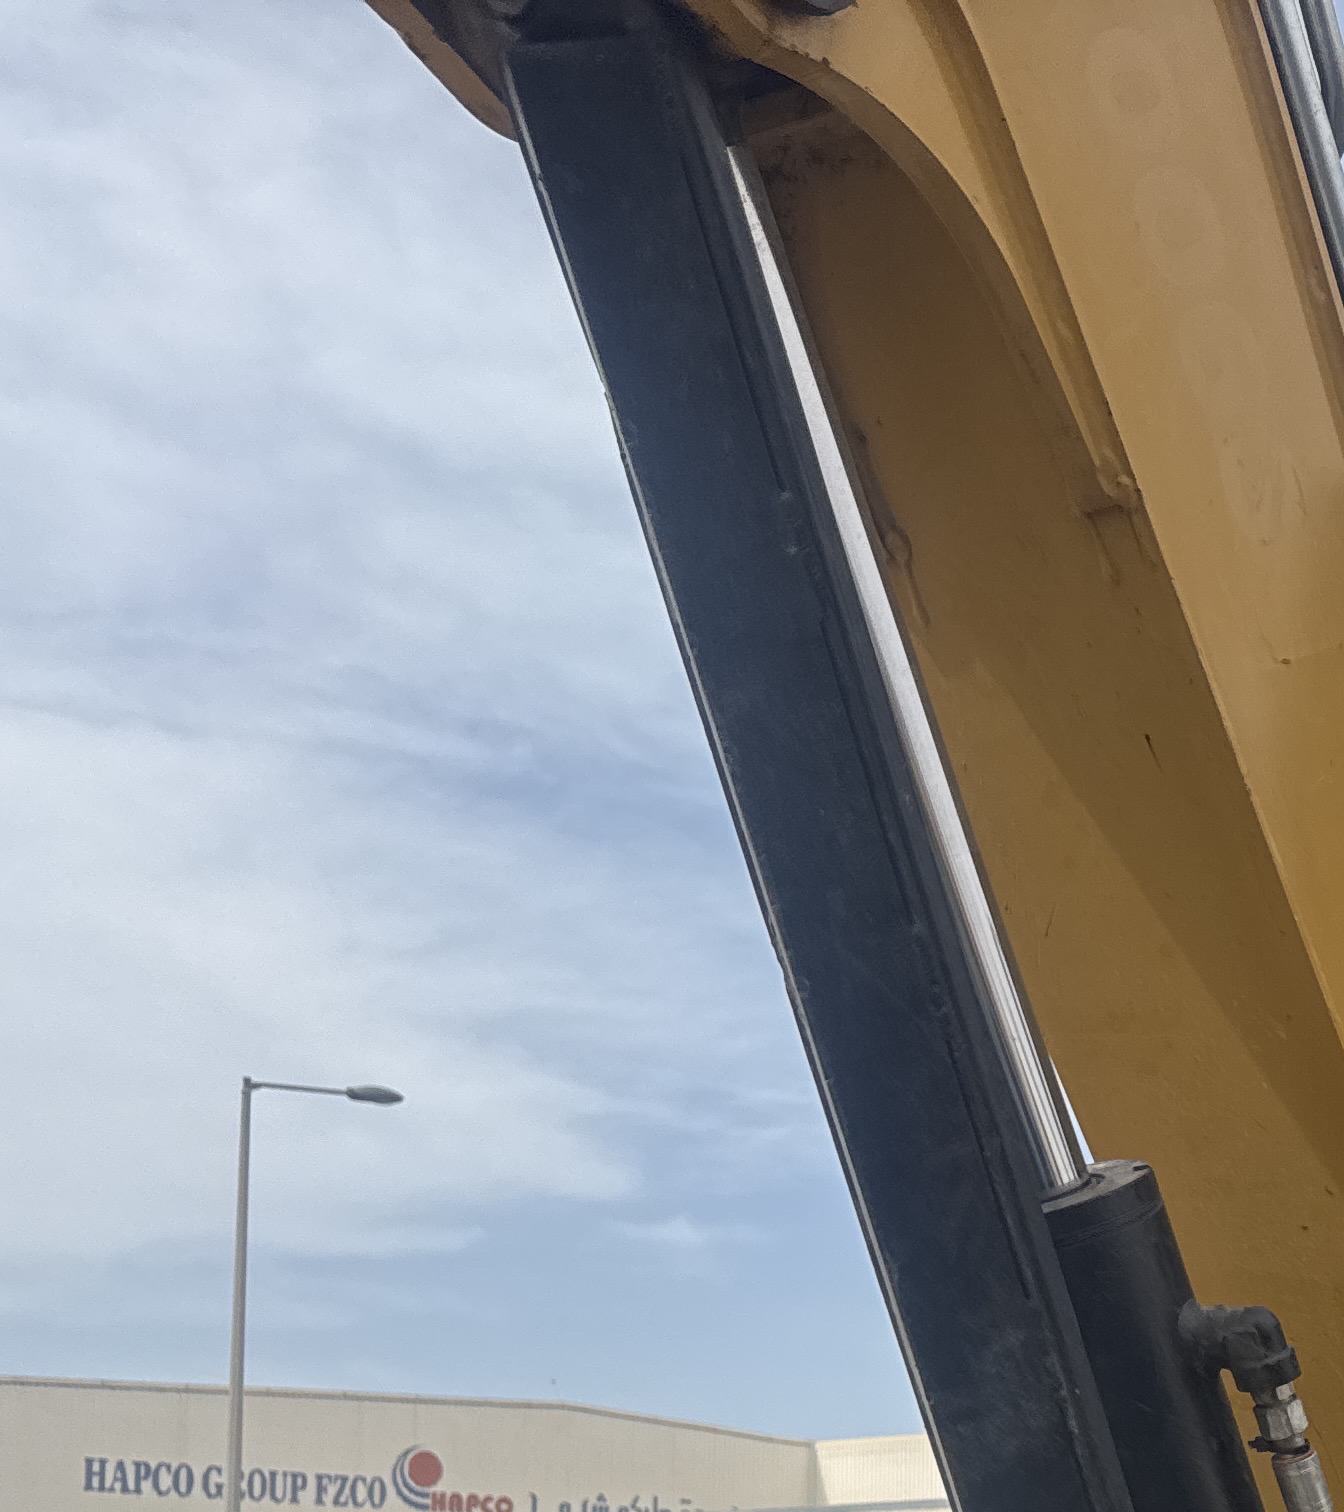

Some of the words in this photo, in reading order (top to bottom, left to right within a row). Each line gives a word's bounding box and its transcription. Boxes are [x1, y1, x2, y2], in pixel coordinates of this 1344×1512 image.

[83, 1456, 195, 1498] HAPCO
[202, 1464, 307, 1505] GOUP
[314, 1472, 387, 1510] FZCO
